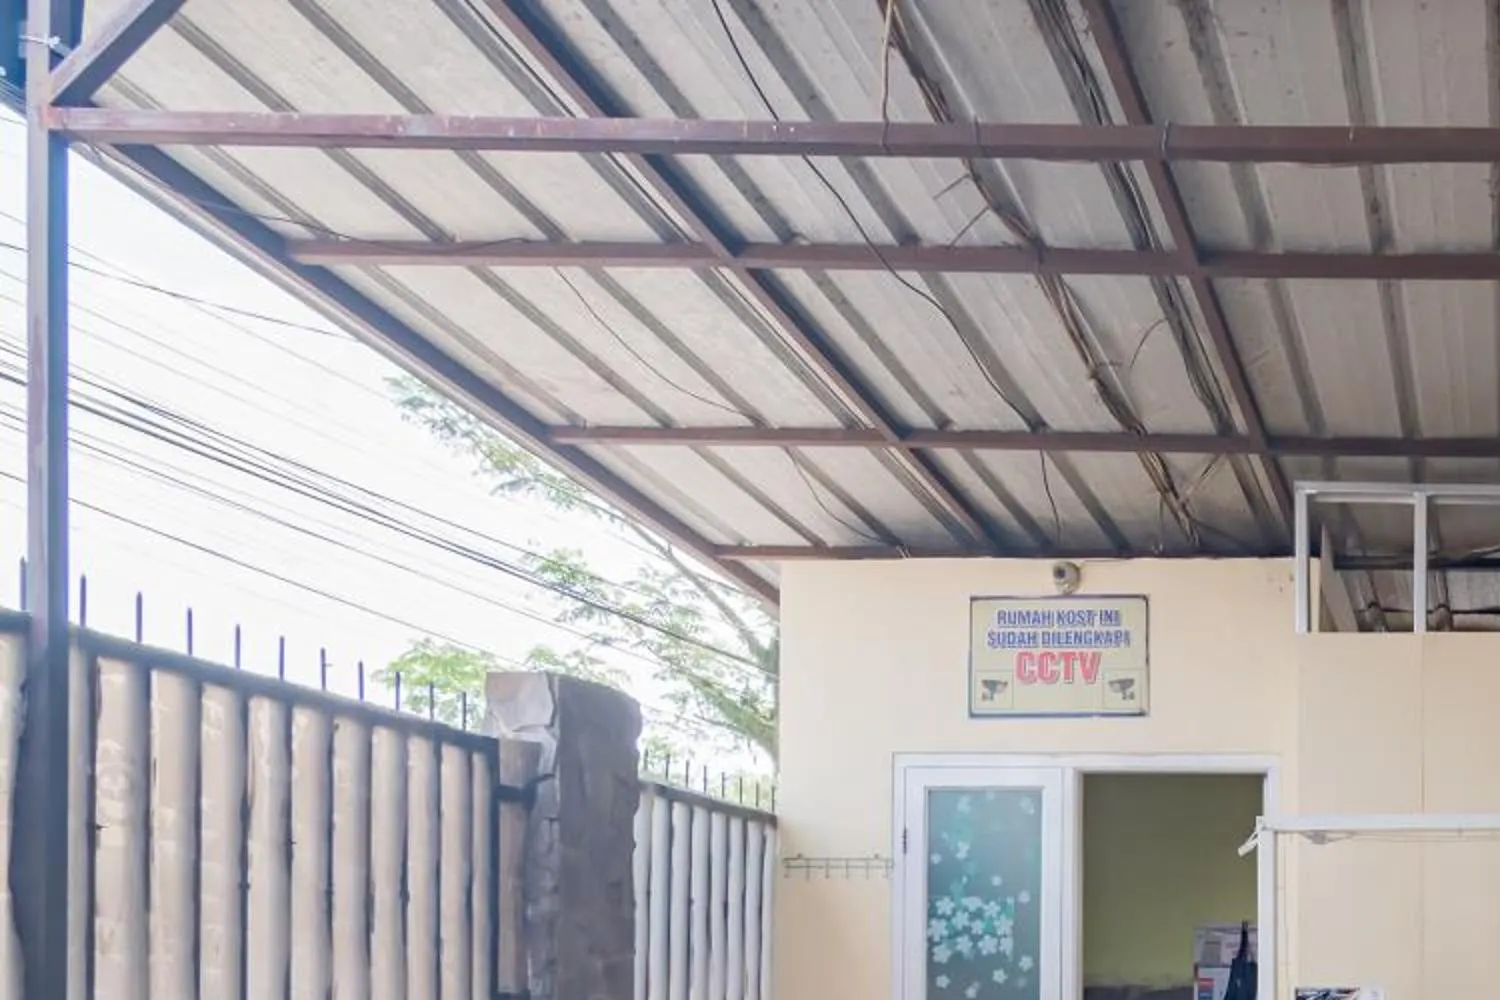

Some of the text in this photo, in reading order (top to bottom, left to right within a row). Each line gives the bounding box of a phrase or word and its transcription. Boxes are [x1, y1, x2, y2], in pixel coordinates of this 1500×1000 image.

[997, 609, 1050, 627] RUMAH
[1055, 609, 1095, 626] KOST
[987, 630, 1038, 648] SUDAH
[1015, 650, 1102, 685] CCTV
